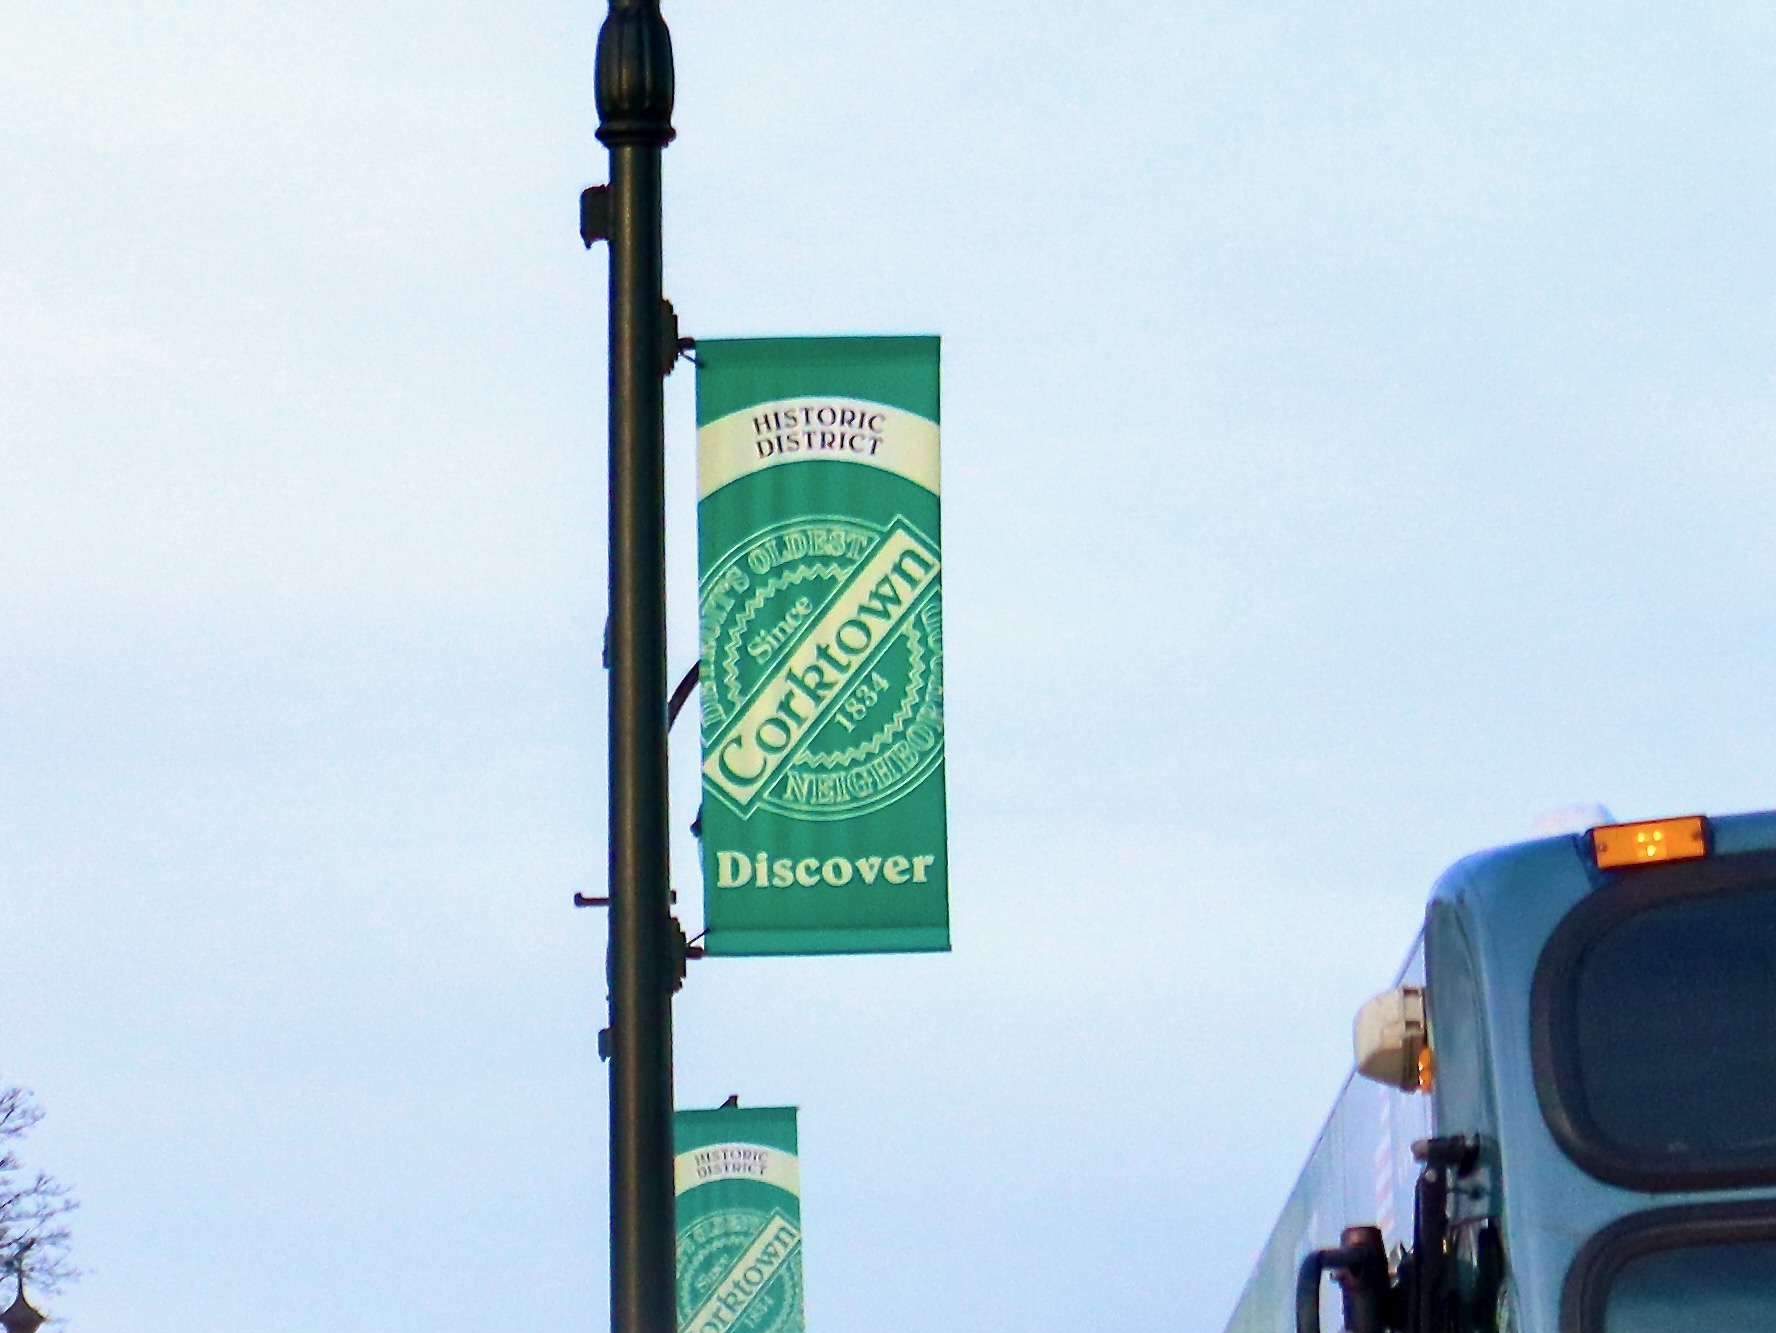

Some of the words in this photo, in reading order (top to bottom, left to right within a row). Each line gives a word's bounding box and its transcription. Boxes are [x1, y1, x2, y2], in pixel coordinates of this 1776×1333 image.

[753, 406, 886, 435] HISTORIC
[756, 431, 883, 458] DISTRICT
[747, 597, 812, 665] Since
[718, 549, 933, 787] Corktown
[834, 671, 889, 732] 1834
[716, 851, 935, 889] Discover
